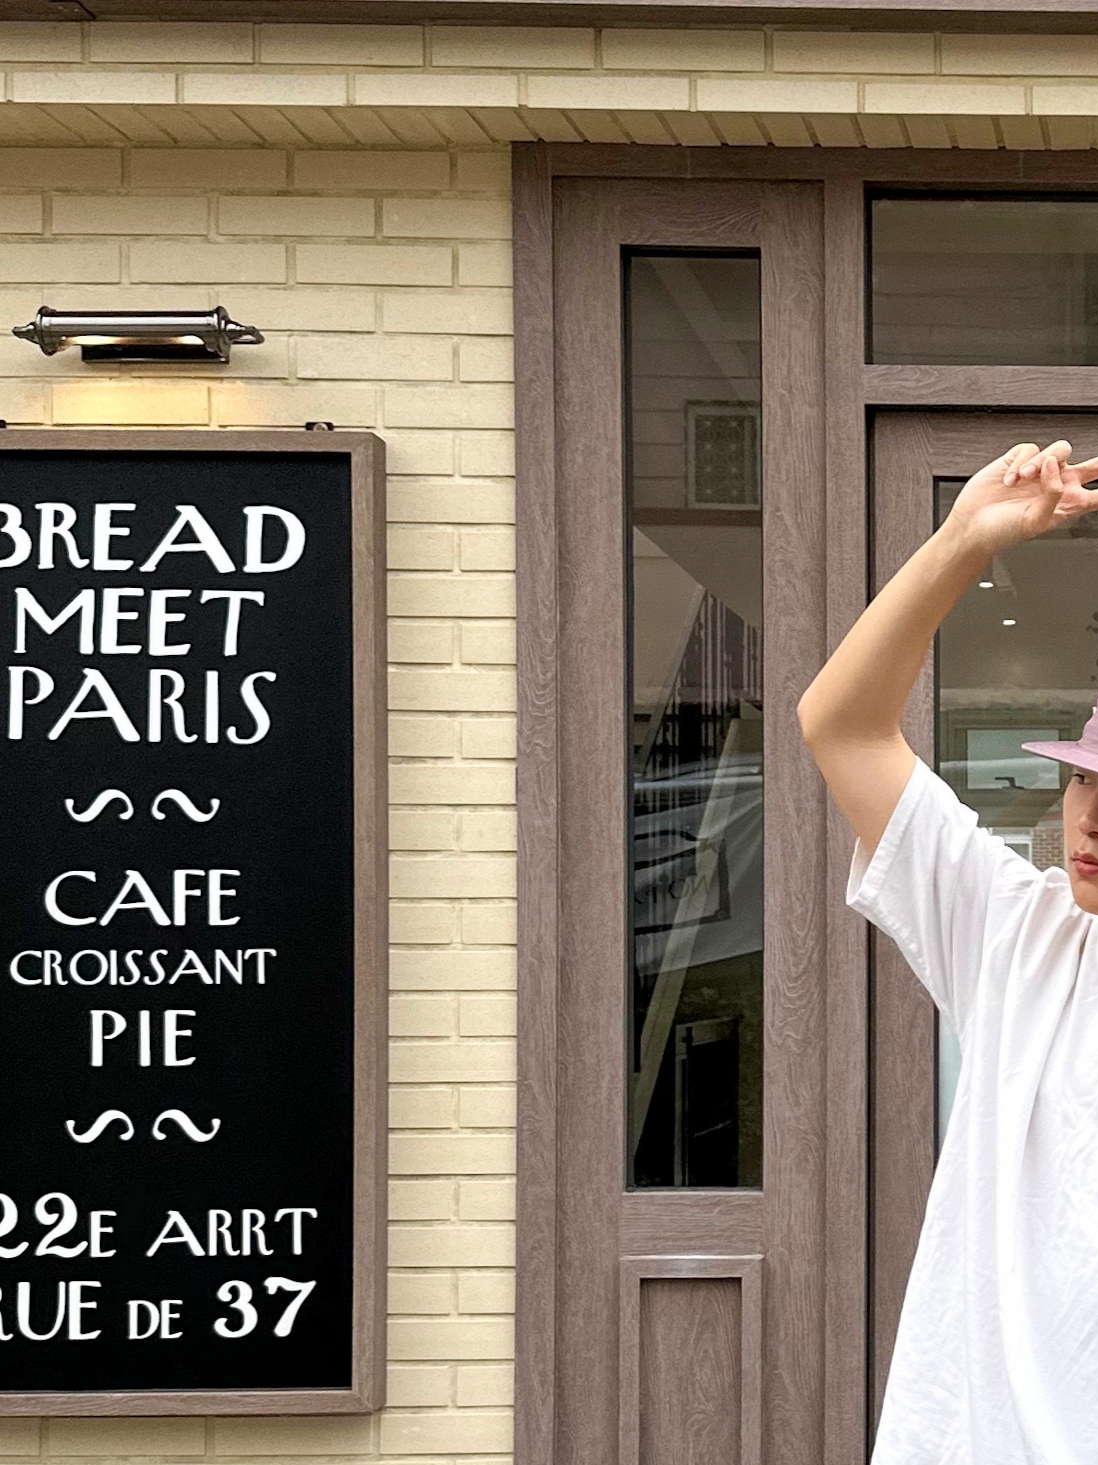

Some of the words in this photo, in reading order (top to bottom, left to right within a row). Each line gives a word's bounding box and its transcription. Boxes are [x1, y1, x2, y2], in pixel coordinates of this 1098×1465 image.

[0, 502, 306, 574] BREAD
[13, 587, 265, 657] MEET
[7, 665, 277, 745] PARIS
[44, 868, 241, 927] CAFE
[9, 948, 277, 986] CROISSANT
[89, 1009, 197, 1067] PIE
[146, 1207, 318, 1258] ARRT
[0, 1280, 102, 1341] UE
[127, 1299, 184, 1340] DE
[213, 1276, 317, 1339] 37
